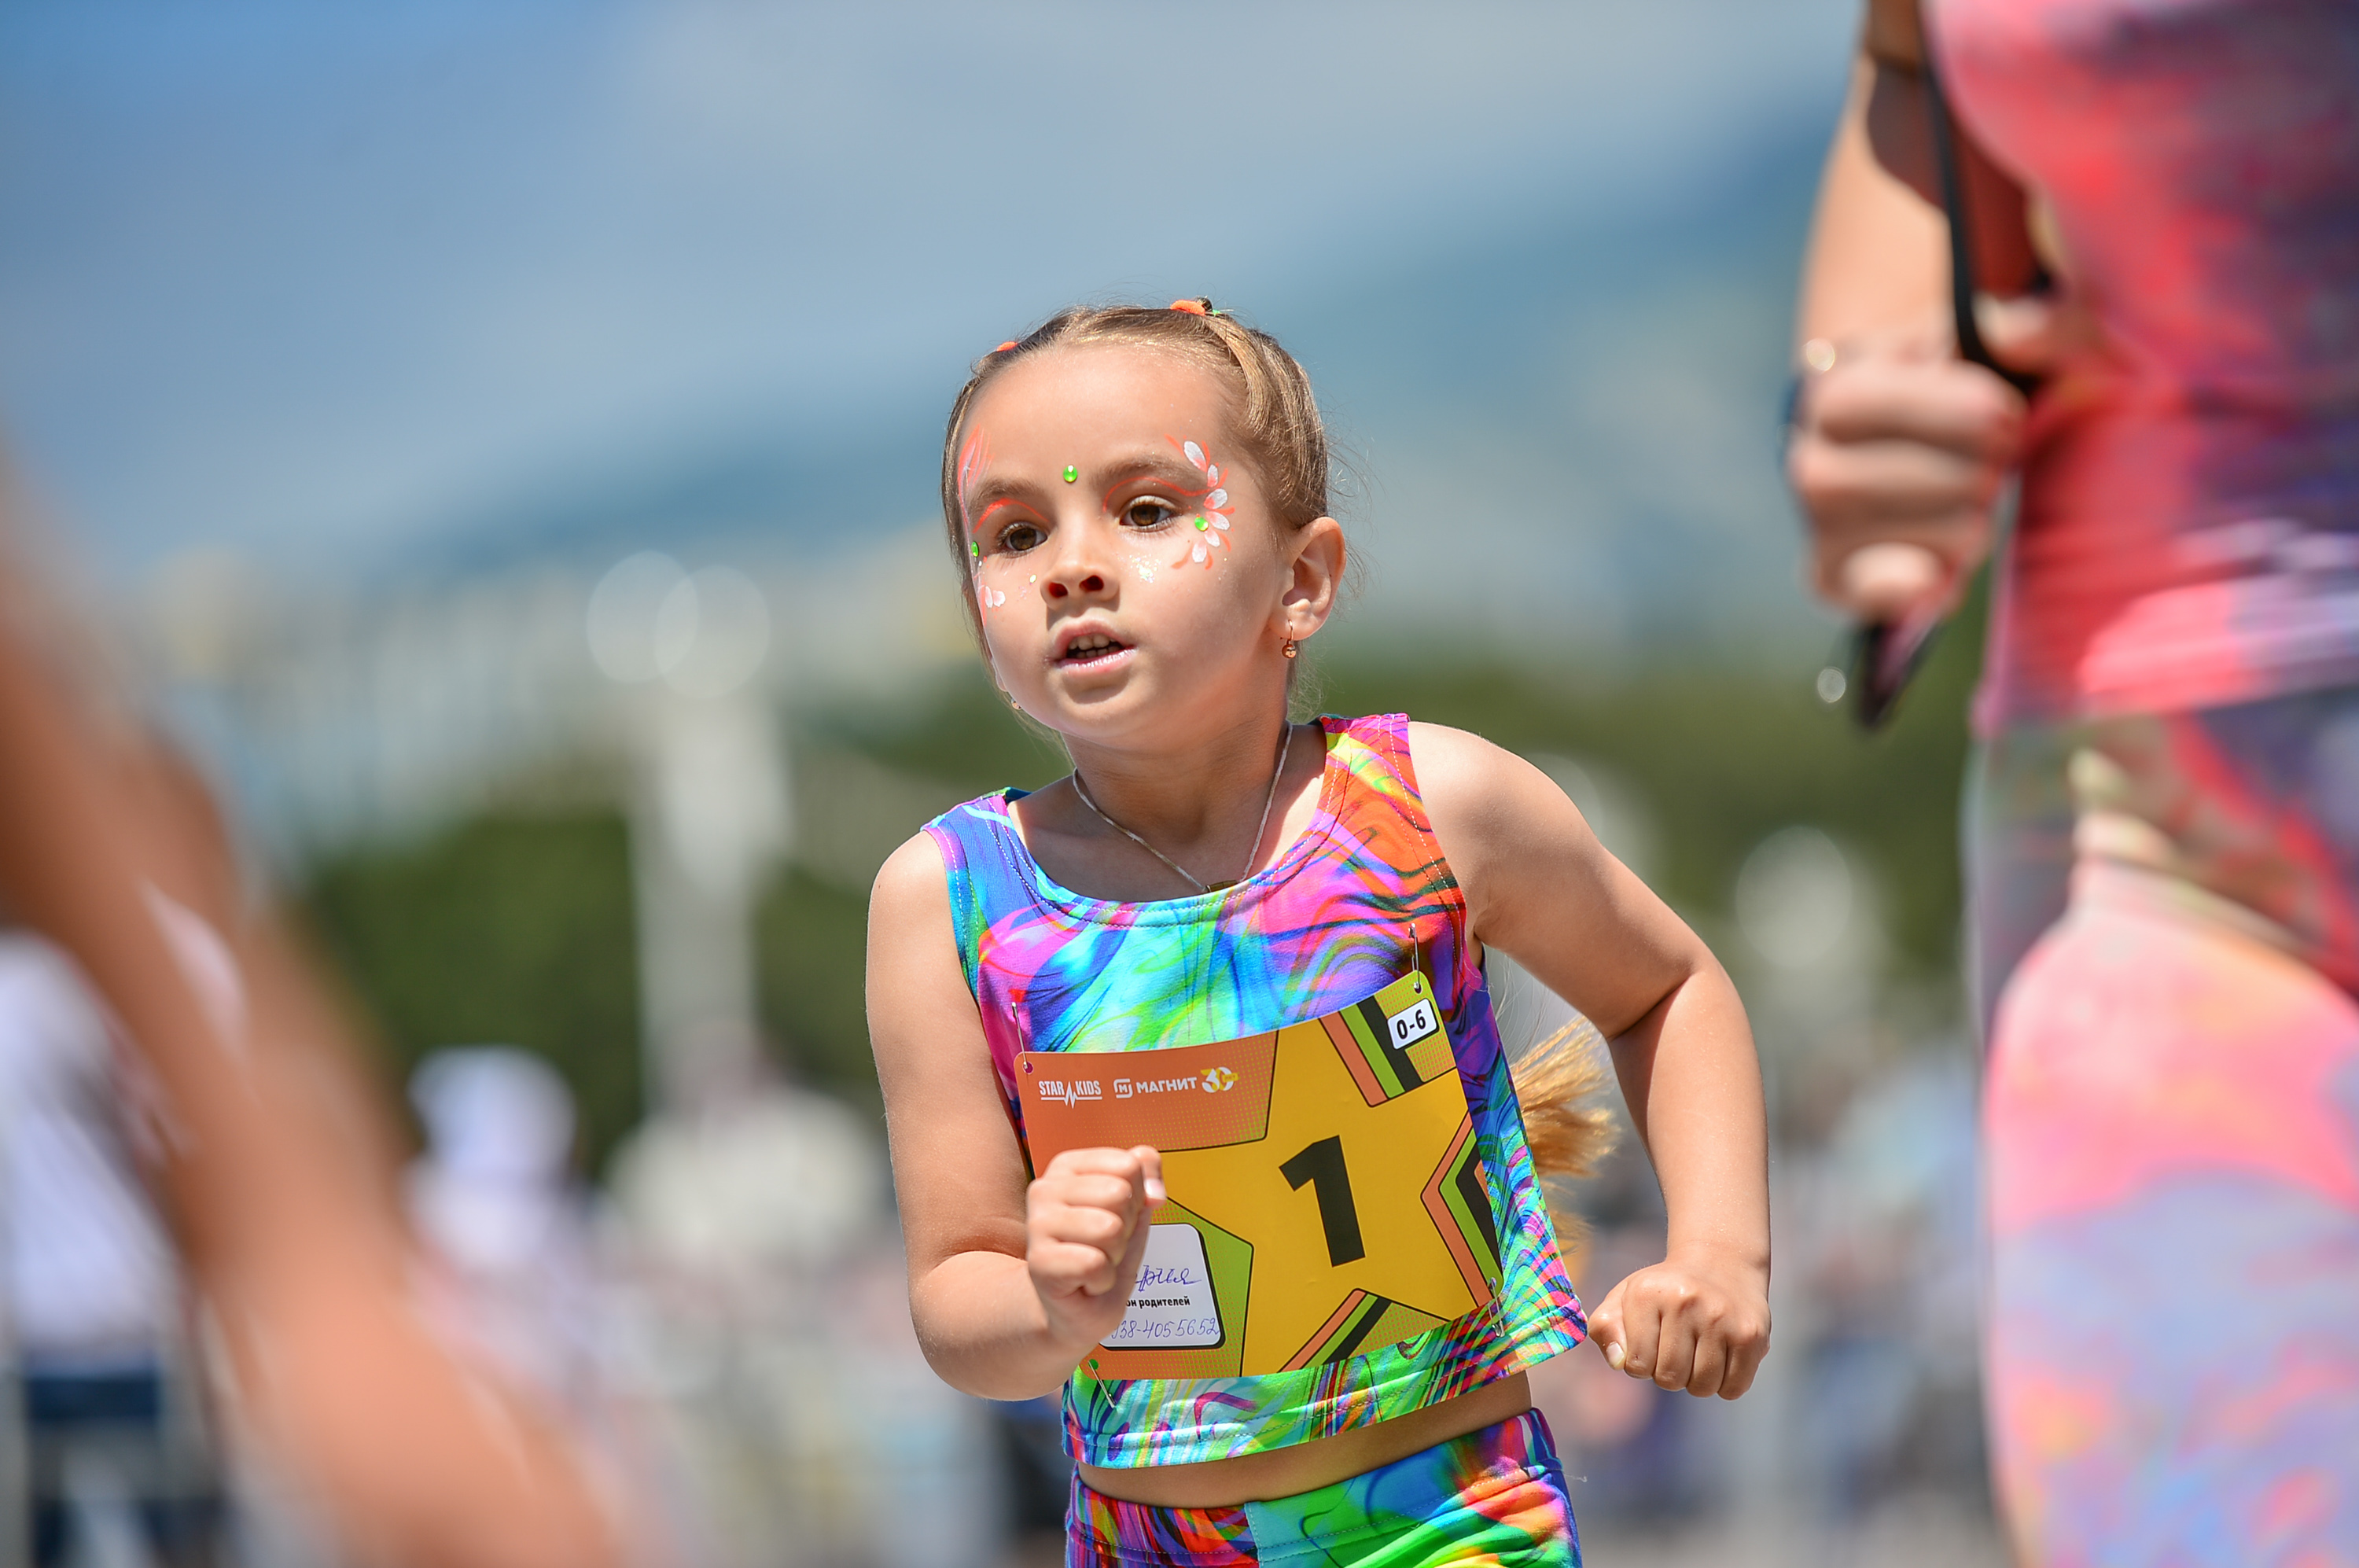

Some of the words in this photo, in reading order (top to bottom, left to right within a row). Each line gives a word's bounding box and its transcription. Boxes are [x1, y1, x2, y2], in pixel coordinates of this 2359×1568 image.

[1397, 1010, 1426, 1040] 0-6
[1038, 1080, 1065, 1095] STAR
[1075, 1080, 1102, 1095] KIDS
[1135, 1077, 1197, 1094] МАГНИТ
[1279, 1135, 1366, 1268] 1
[1135, 1264, 1202, 1292] рия
[1139, 1295, 1191, 1309] родителей
